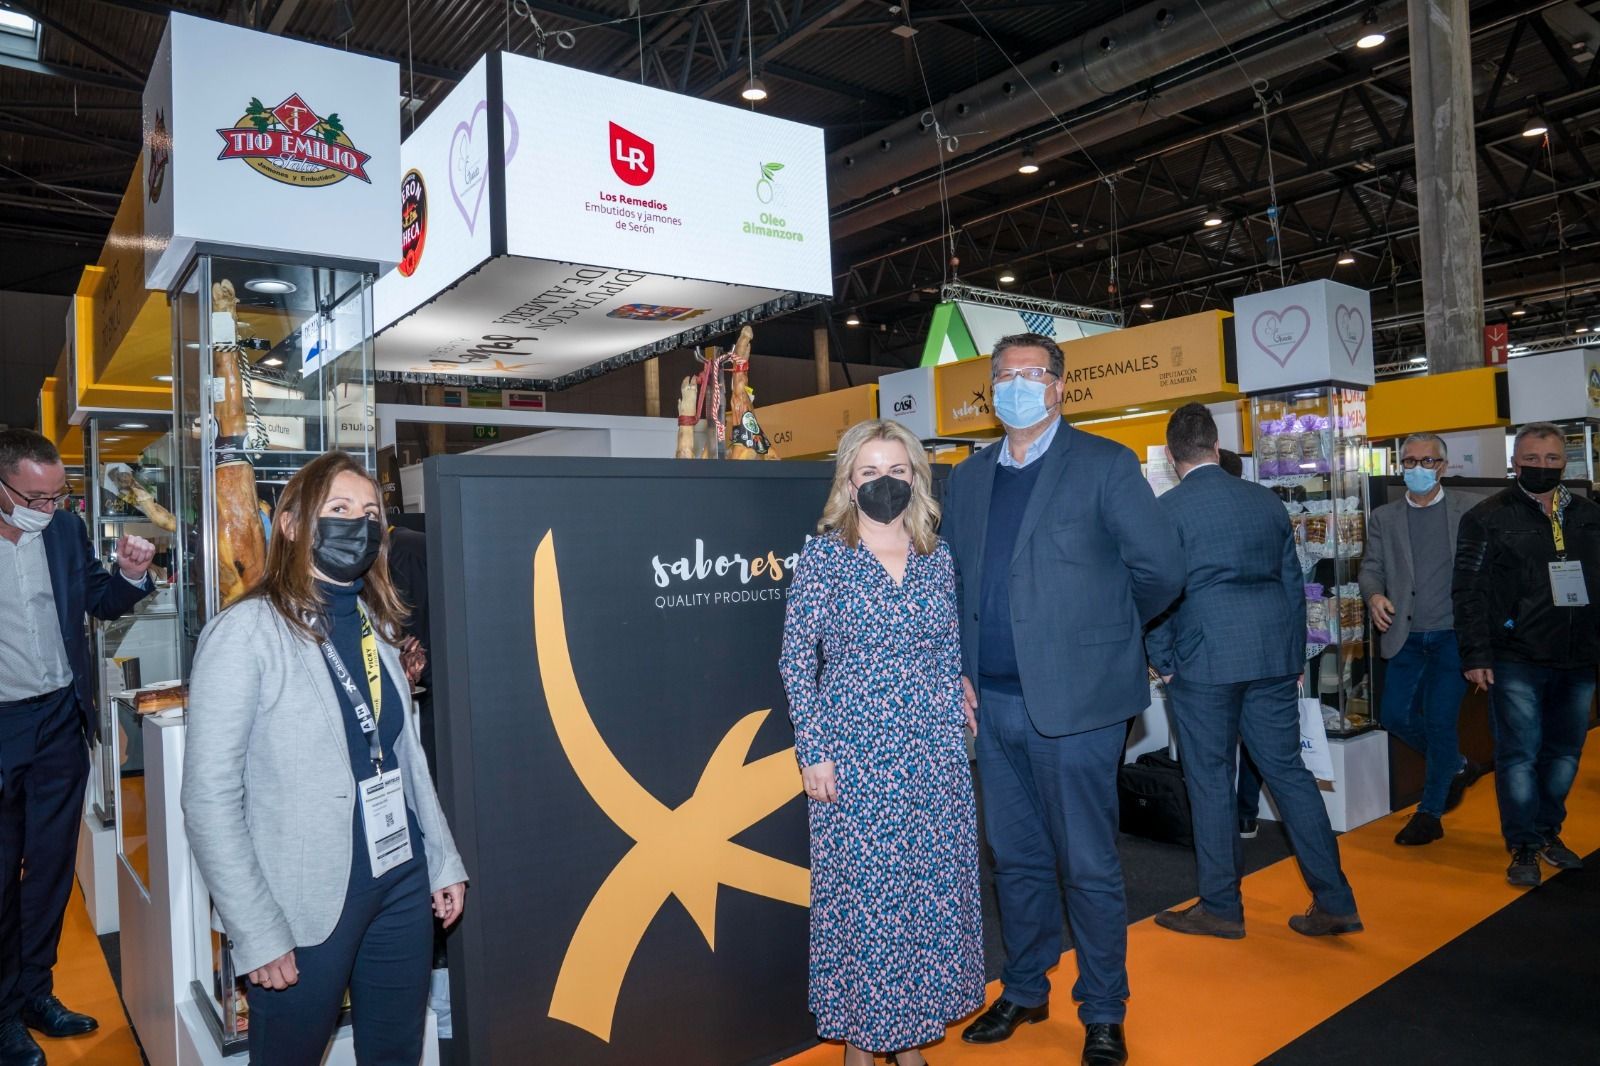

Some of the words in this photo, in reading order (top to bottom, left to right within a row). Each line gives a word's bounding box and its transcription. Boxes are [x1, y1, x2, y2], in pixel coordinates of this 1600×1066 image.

[230, 133, 273, 151] TIO
[281, 134, 358, 170] EMILIO
[616, 138, 649, 173] LR
[257, 162, 289, 179] Jamones
[300, 173, 336, 182] Embutidos
[402, 180, 421, 204] ERON
[599, 191, 617, 203] Los
[619, 194, 668, 211] Remedios
[585, 201, 636, 218] Embutidos
[643, 211, 682, 226] jamones
[760, 212, 786, 227] Oleo
[615, 220, 627, 231] de
[628, 221, 655, 234] Serón
[742, 221, 804, 241] almanzora
[562, 268, 609, 287] DE
[491, 285, 577, 325] ALMERÍA
[524, 271, 647, 332] DIPUTACIÓN
[1064, 355, 1159, 384] ARTESANALES
[1159, 367, 1198, 380] DIPUTACIÓN
[1169, 375, 1198, 386] ALMERÍA
[1061, 387, 1093, 404] ADA
[893, 400, 912, 412] CASI
[774, 430, 793, 444] CASI
[655, 592, 711, 609] QUALITY
[714, 588, 781, 604] PRODUCTS
[365, 648, 374, 669] VICKY
[1300, 740, 1313, 749] AL
